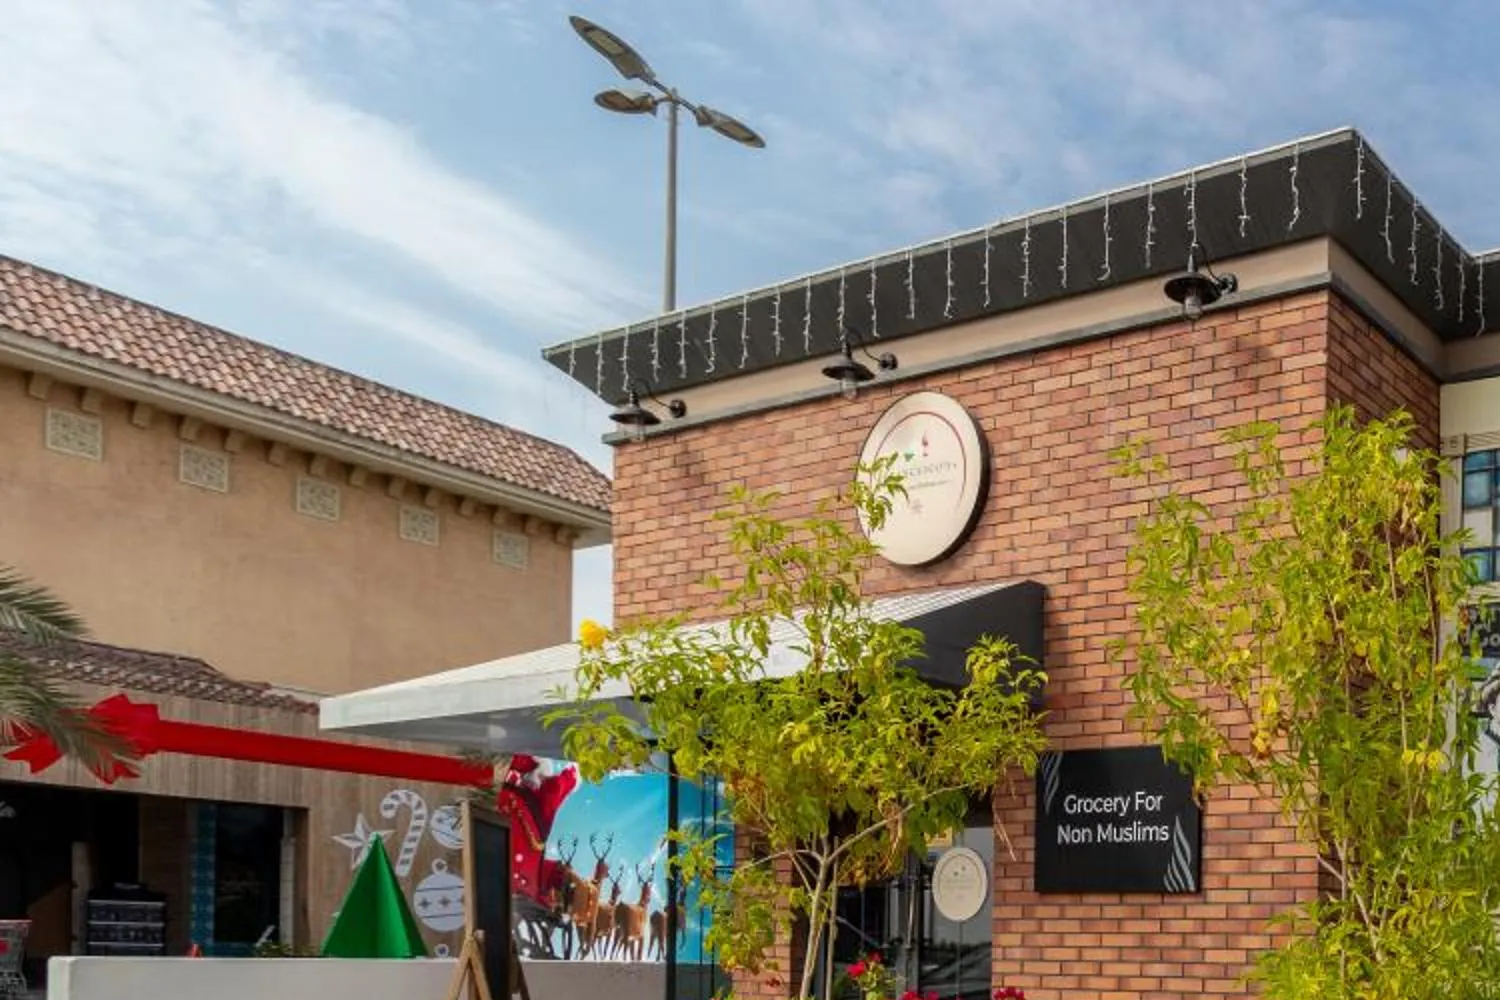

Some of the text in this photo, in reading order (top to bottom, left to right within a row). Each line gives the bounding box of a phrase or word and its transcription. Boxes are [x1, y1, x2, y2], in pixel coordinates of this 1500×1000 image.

[1063, 791, 1164, 817] Grocery For
[1056, 821, 1169, 845] Non Muslims
